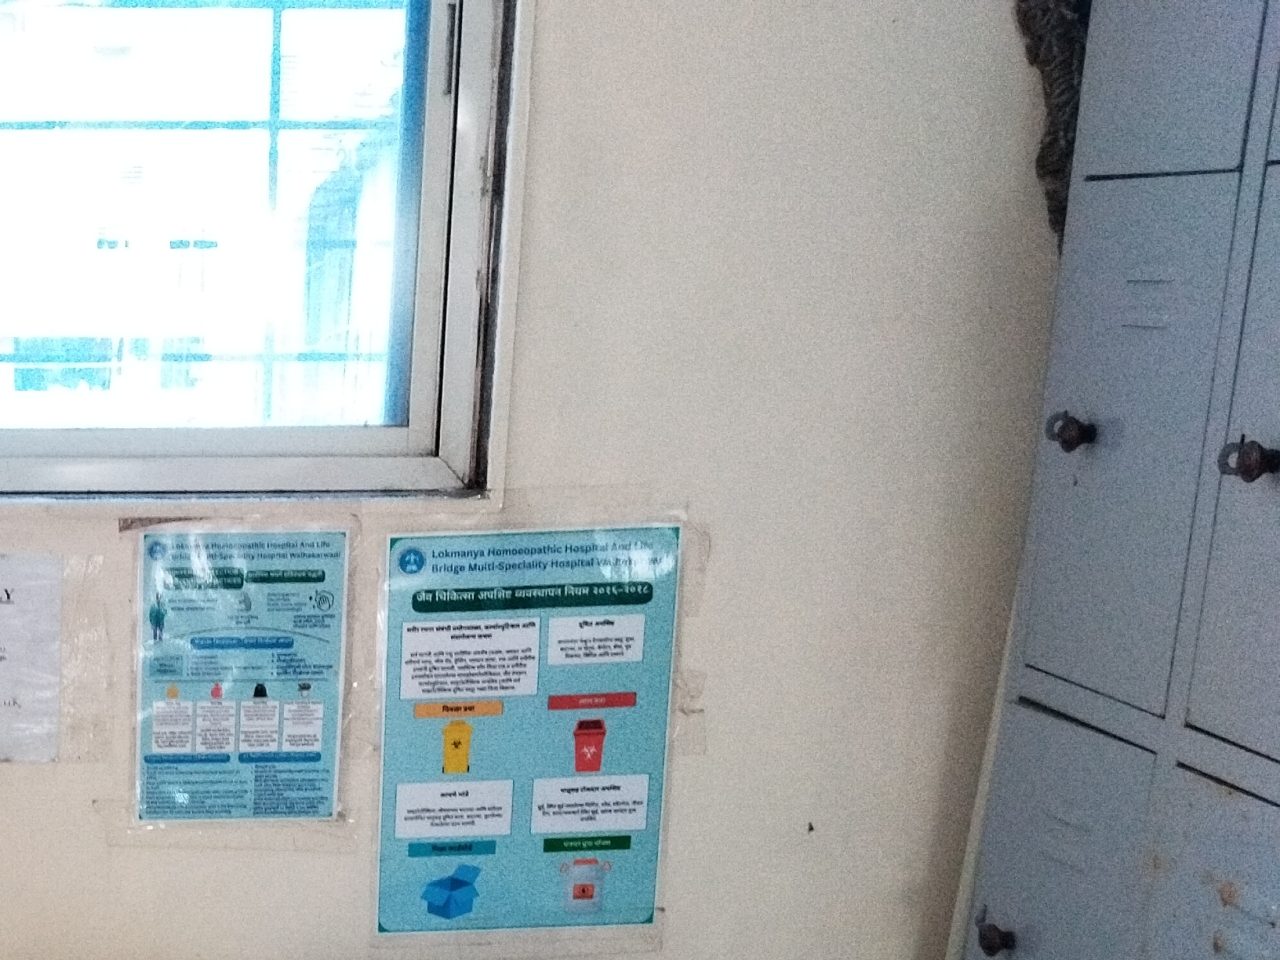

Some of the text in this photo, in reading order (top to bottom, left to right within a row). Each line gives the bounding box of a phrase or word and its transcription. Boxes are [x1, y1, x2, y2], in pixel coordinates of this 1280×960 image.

[432, 549, 485, 561] Lokmanya
[432, 563, 466, 576] Bridge
[551, 557, 595, 570] Hospital
